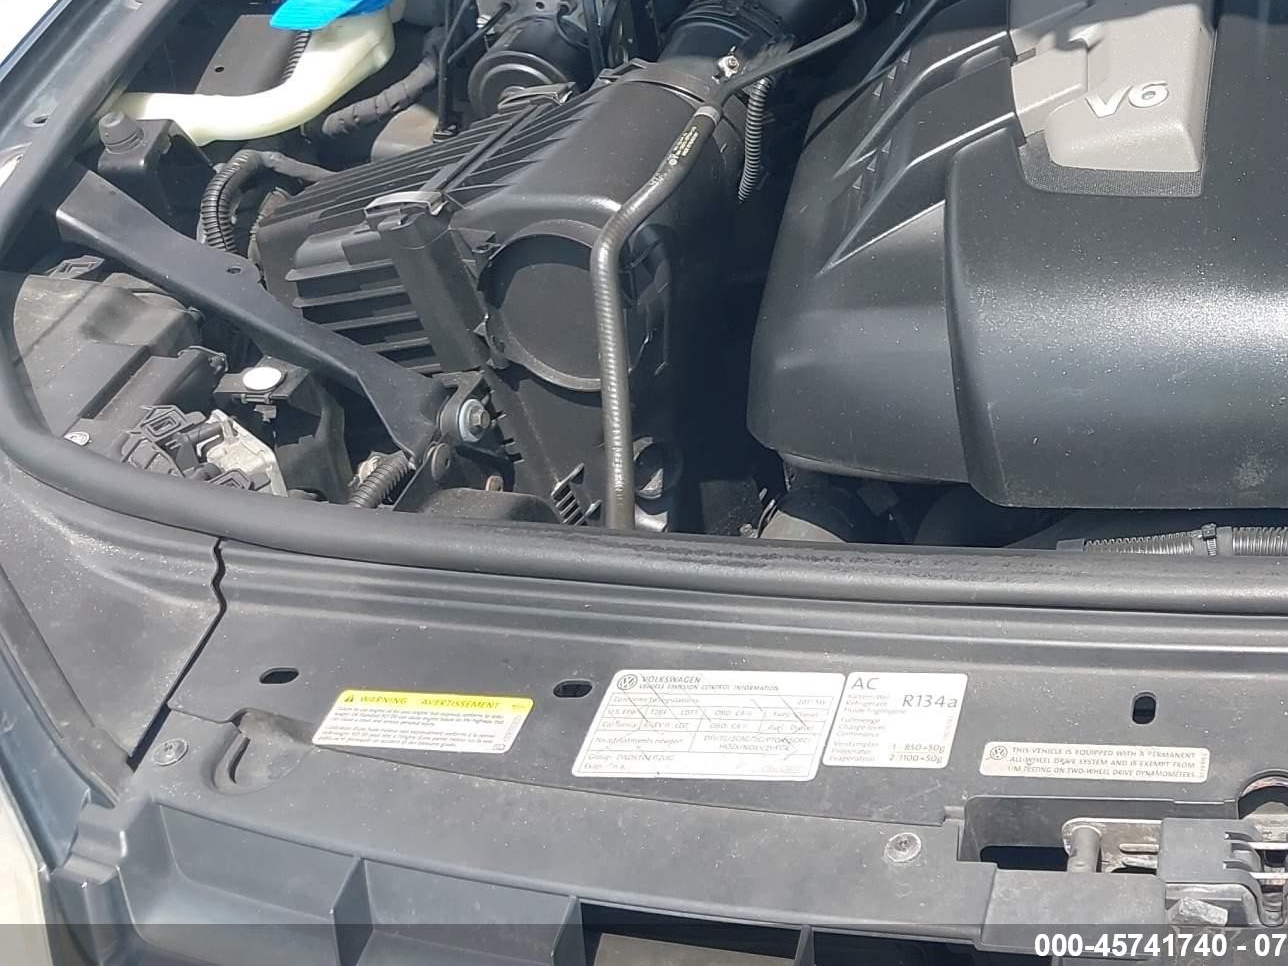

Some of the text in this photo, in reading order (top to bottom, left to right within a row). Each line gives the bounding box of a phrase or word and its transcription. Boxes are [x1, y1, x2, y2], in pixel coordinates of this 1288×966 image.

[1085, 81, 1169, 118] V6
[641, 675, 701, 683] VOLKSWAGEN
[851, 677, 880, 689] AC
[361, 696, 407, 704] WARNING
[421, 698, 500, 709] AVERTISSEMENT
[902, 694, 958, 708] R134a
[1147, 750, 1196, 758] PERMANENT
[1113, 768, 1134, 776] DRIVE
